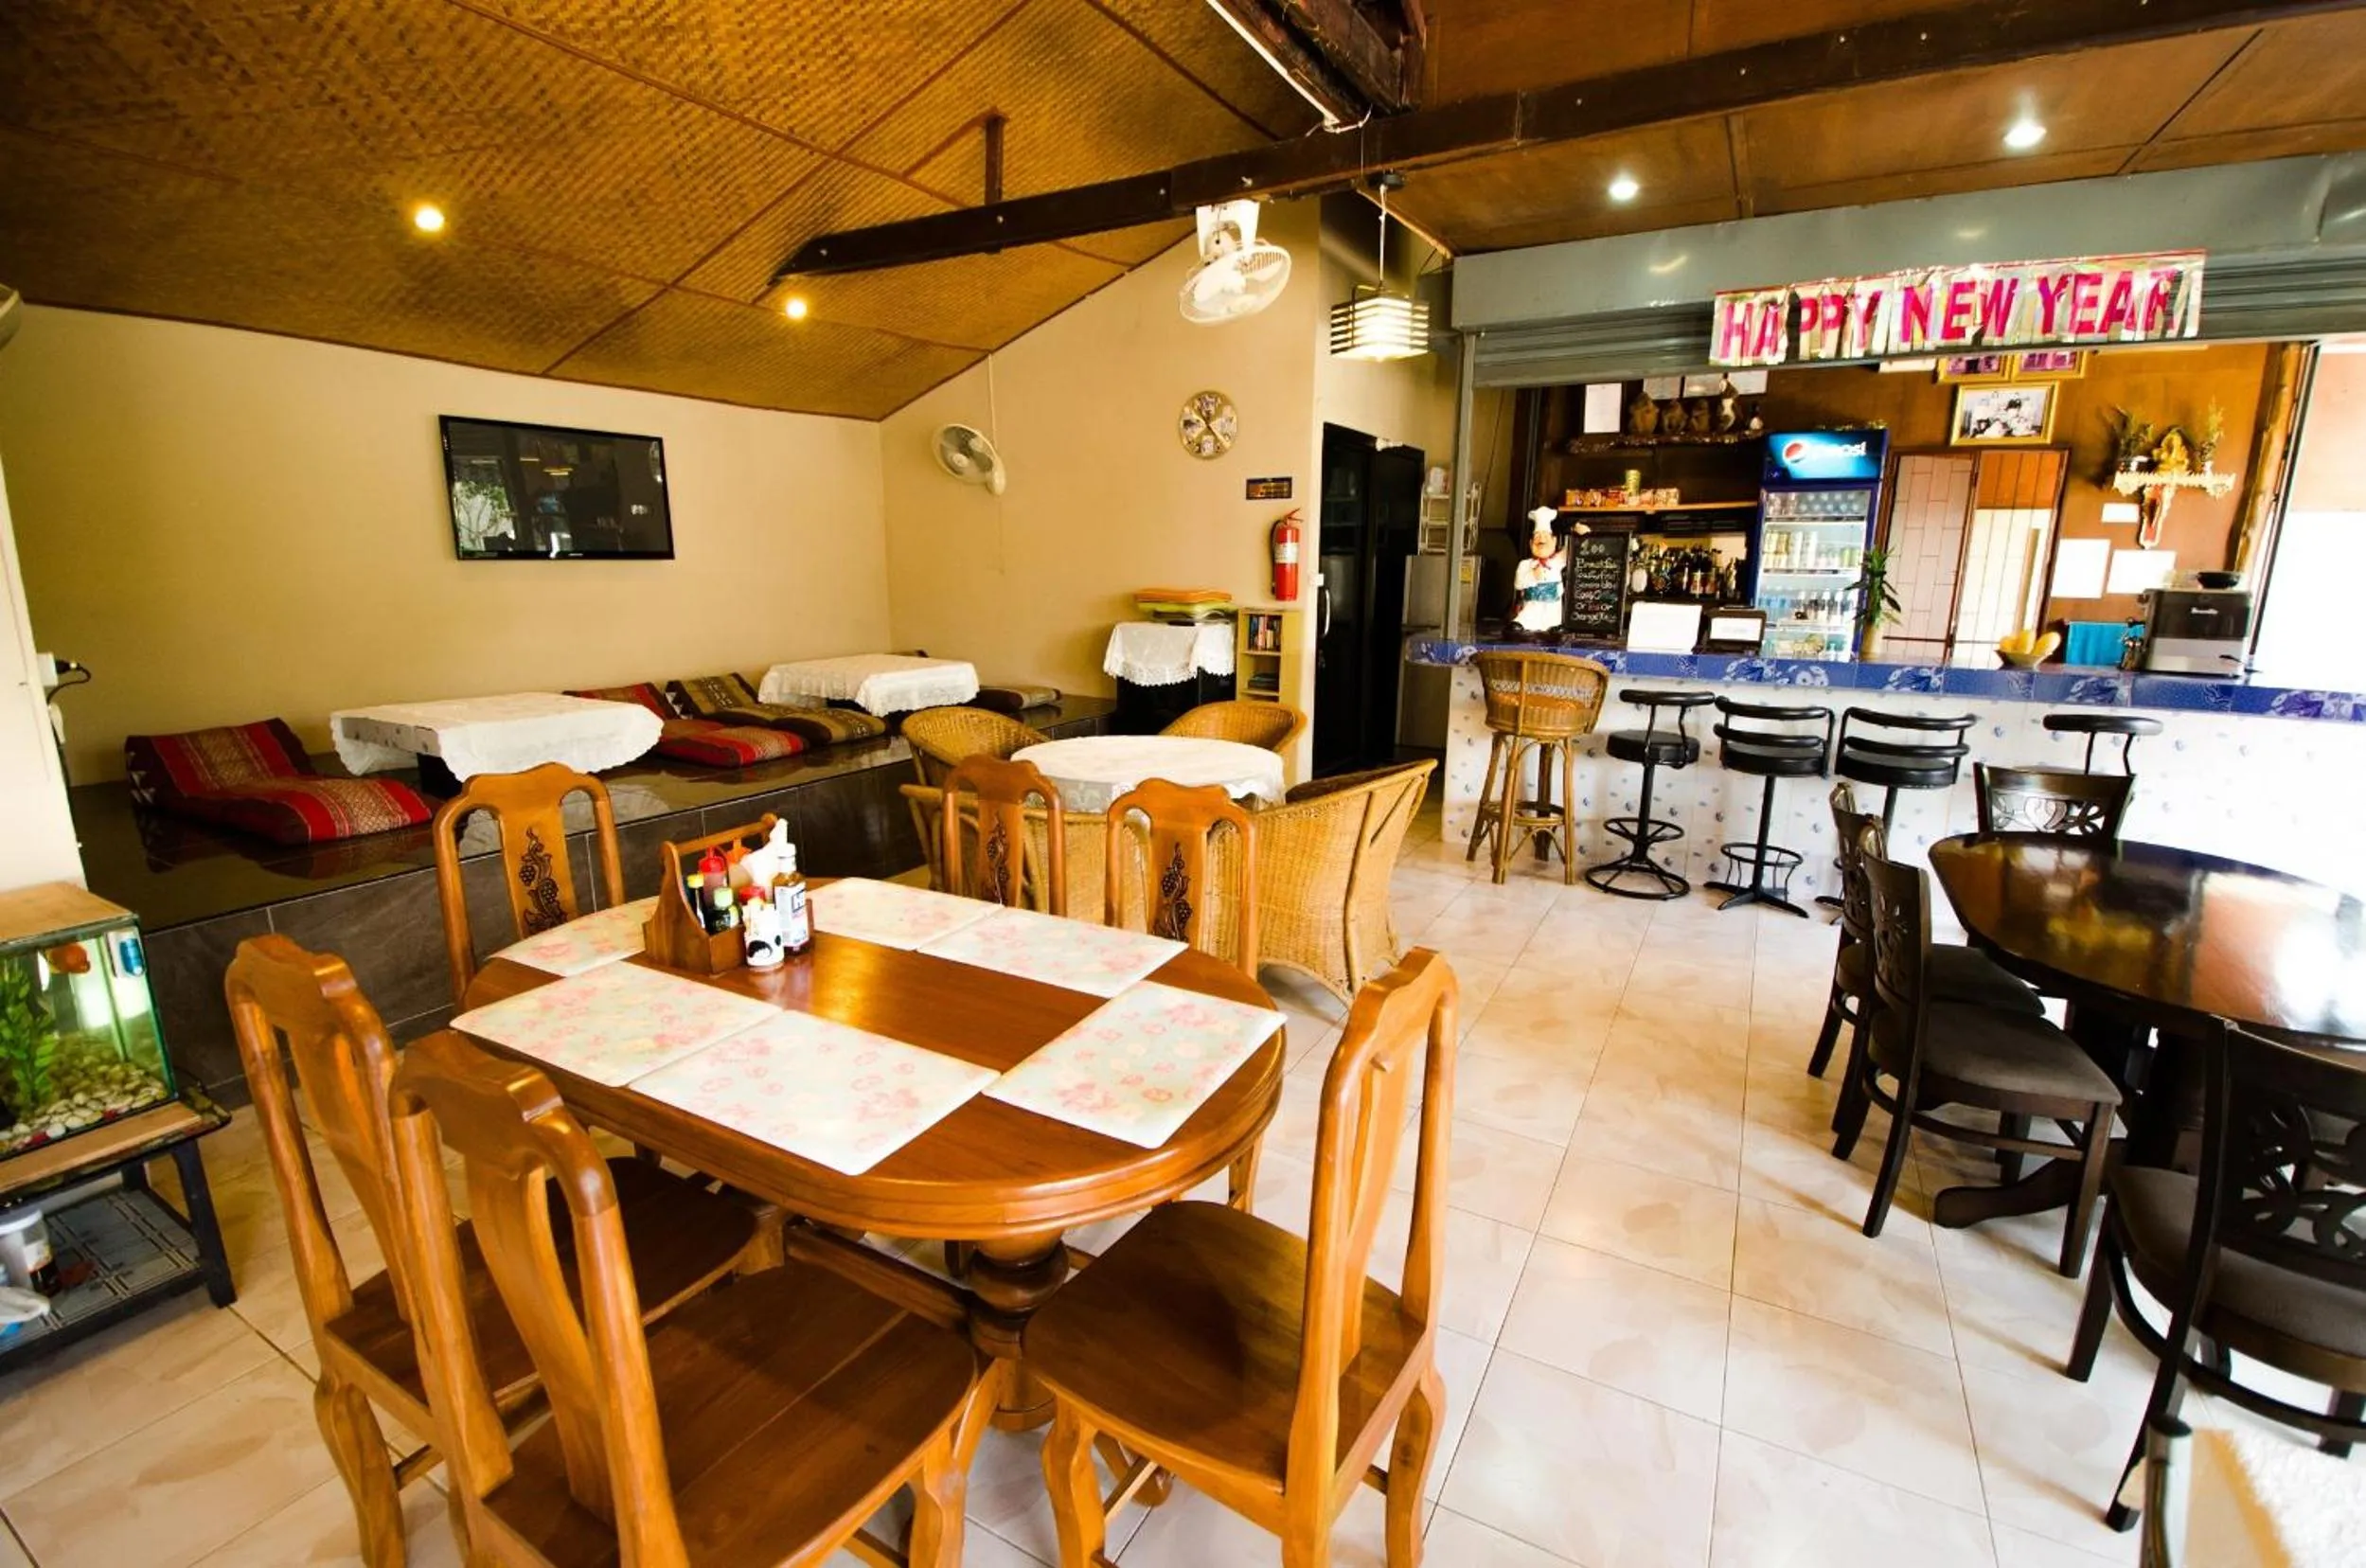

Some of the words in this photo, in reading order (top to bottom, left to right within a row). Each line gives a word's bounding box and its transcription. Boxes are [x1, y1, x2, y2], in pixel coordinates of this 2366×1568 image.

[1718, 291, 1882, 359] HAPPY
[1900, 277, 2019, 343] NEW
[2037, 269, 2183, 335] YEAR
